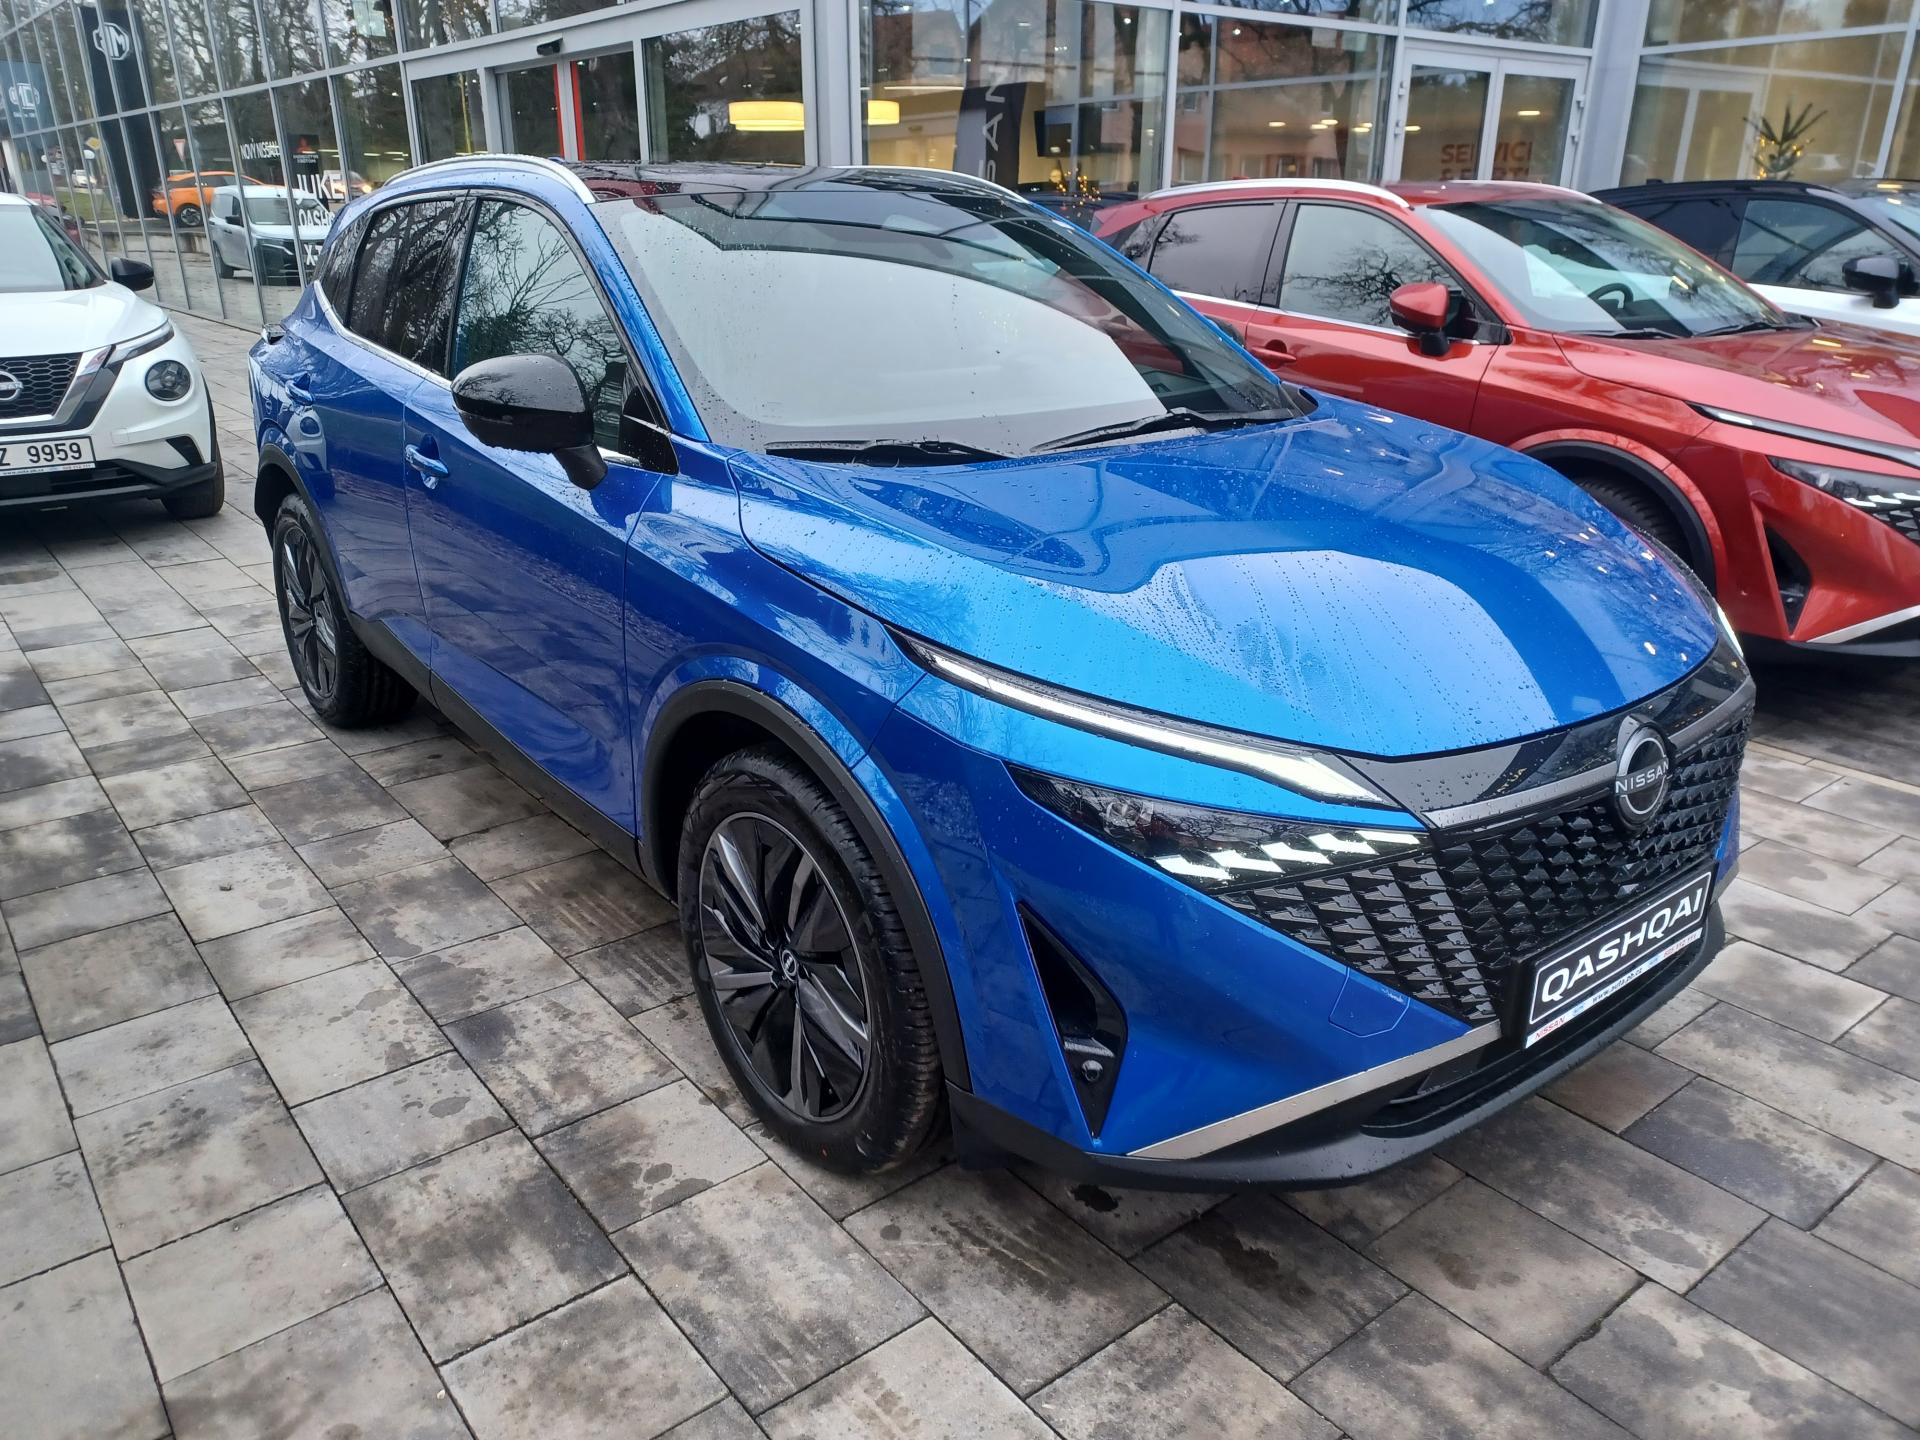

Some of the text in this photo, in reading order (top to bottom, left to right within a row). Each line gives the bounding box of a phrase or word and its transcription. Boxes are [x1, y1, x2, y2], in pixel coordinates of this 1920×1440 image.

[297, 172, 345, 201] JUKE
[27, 442, 82, 464] 9959
[1615, 761, 1669, 794] NISSAN
[1541, 887, 1703, 1002] QASHQAI
